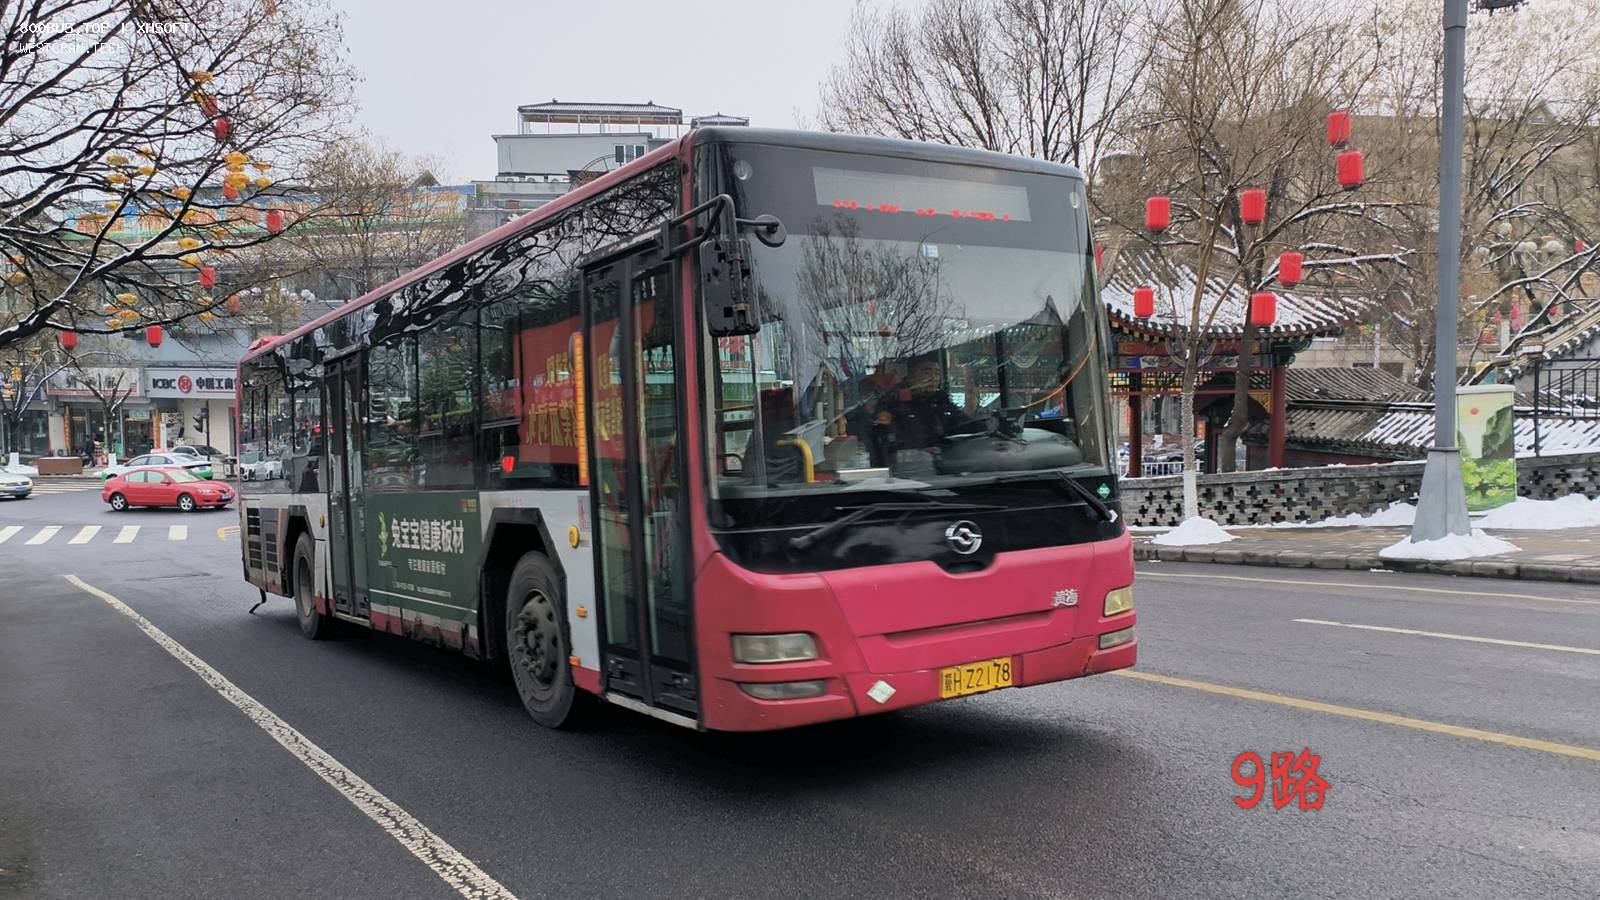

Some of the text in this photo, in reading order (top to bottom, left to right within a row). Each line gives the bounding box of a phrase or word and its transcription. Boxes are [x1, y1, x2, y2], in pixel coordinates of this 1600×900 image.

[152, 377, 236, 390] ICBC 中国工商
